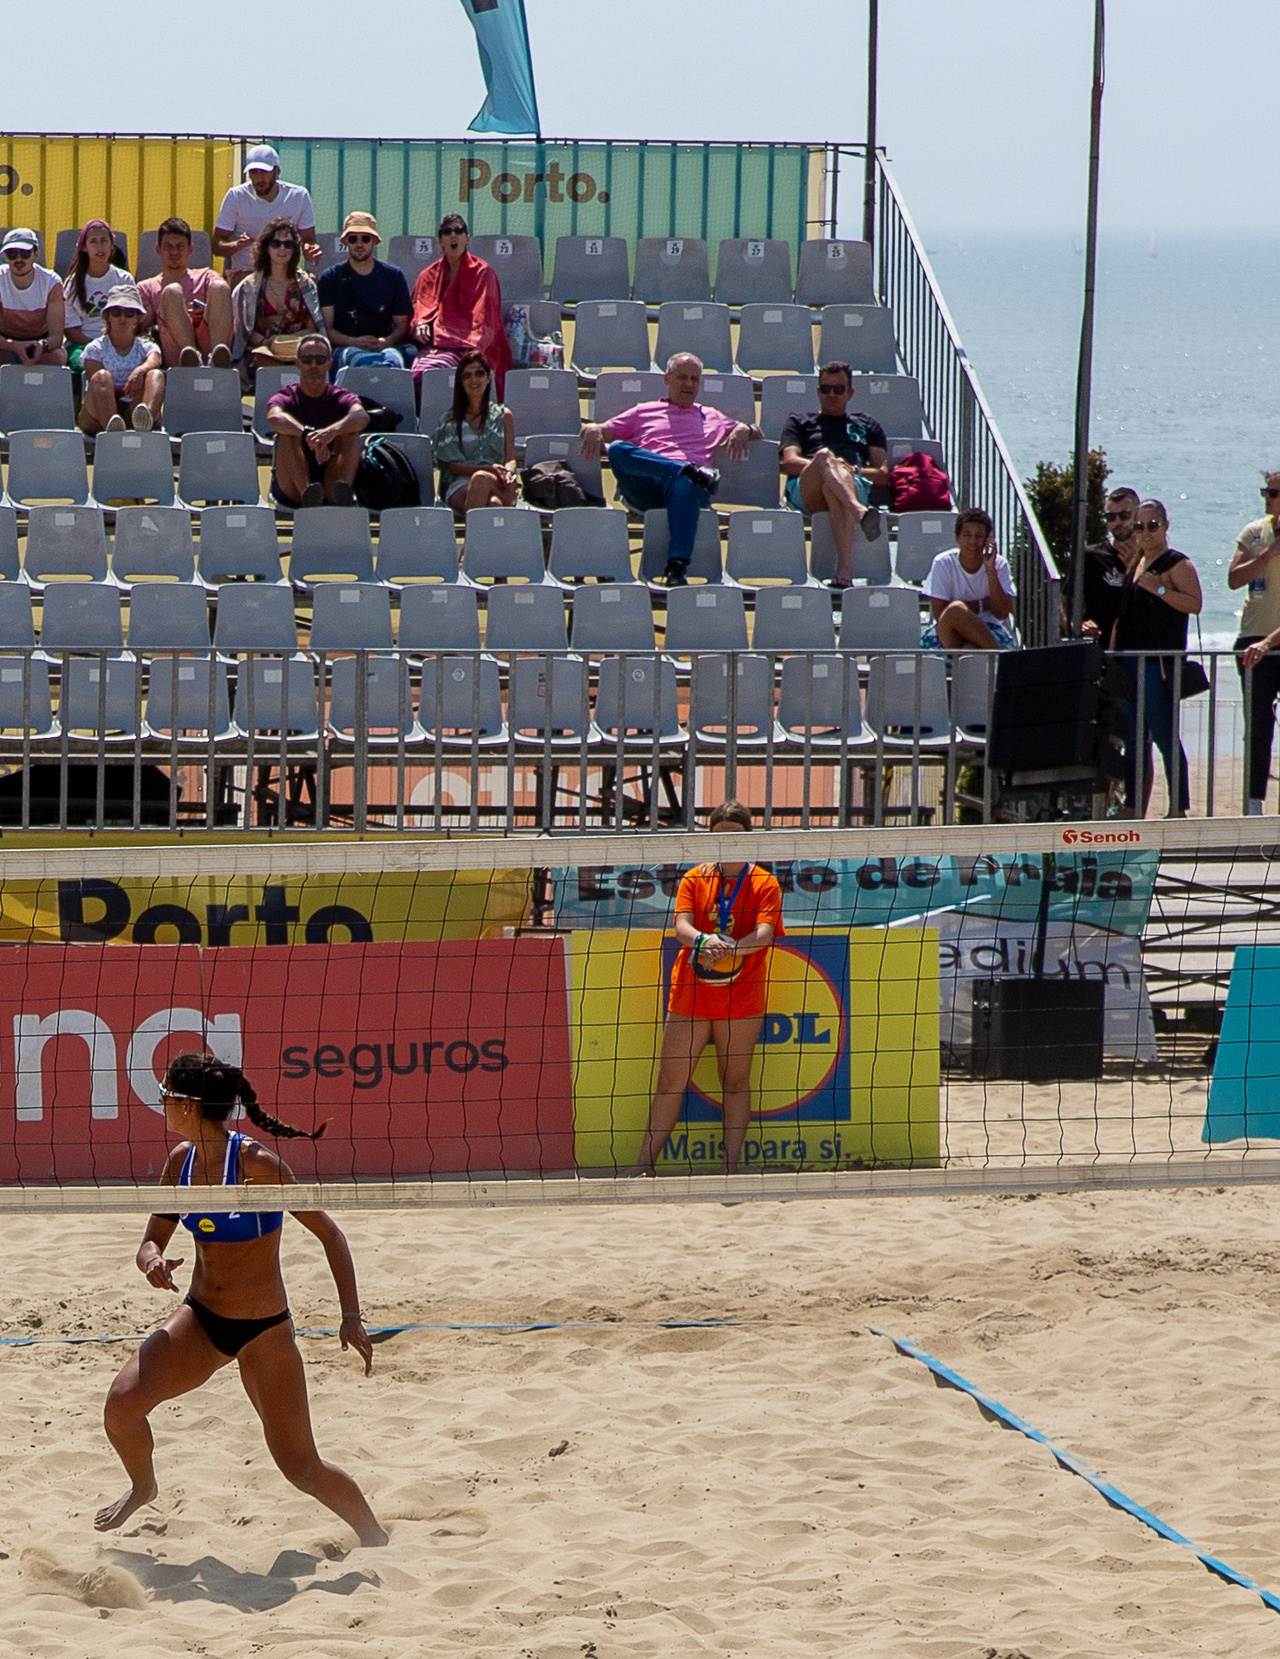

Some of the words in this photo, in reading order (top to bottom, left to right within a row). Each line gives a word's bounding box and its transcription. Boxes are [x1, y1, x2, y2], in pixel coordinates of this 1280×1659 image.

[458, 158, 611, 204] Porto.
[1080, 829, 1140, 843] Senoh
[856, 857, 941, 890] de
[956, 855, 1133, 901] Praia
[282, 1039, 509, 1089] seguros
[744, 1138, 808, 1165] para
[819, 1132, 852, 1160] si.
